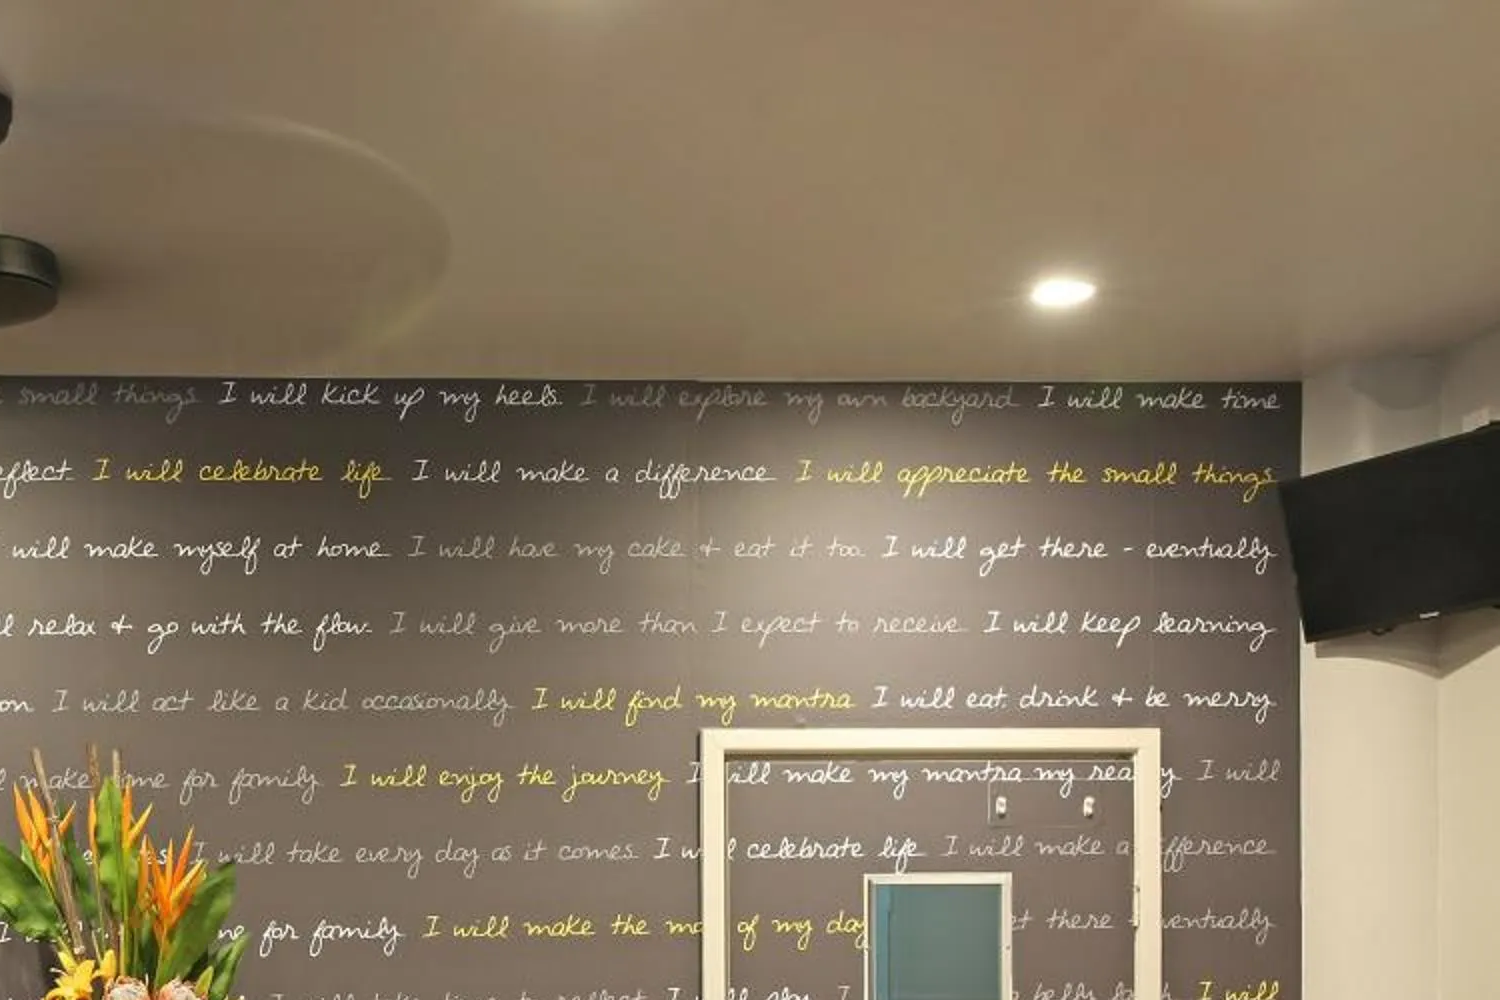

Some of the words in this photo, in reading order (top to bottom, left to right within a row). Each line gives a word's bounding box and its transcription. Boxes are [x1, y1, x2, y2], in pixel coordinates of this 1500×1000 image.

[392, 385, 426, 423] up
[1066, 385, 1124, 411] will
[1135, 386, 1207, 411] make
[1219, 387, 1282, 411] time
[197, 456, 326, 484] celebrate
[514, 457, 591, 485] make
[826, 459, 885, 485] will
[896, 459, 1033, 500] appreciate
[1099, 460, 1179, 486] small
[10, 534, 72, 561] will
[171, 534, 262, 577] myself
[271, 534, 305, 560] at
[626, 534, 687, 560] cake
[733, 534, 777, 560] eat
[978, 533, 1028, 579] get
[1037, 534, 1110, 560] there
[26, 611, 98, 638] relax
[146, 620, 181, 657] go
[190, 610, 248, 636] with
[258, 610, 305, 636] the
[487, 616, 543, 656] give
[636, 610, 699, 635] than
[710, 609, 728, 634] I
[740, 610, 823, 650] expect
[834, 609, 860, 633] to
[150, 687, 196, 714] act
[205, 687, 262, 714] like
[274, 695, 291, 713] a
[623, 683, 684, 729] find
[1017, 682, 1101, 710] drink
[1143, 684, 1172, 709] be
[178, 766, 220, 808] for
[437, 768, 506, 805] enjoy
[780, 759, 856, 786] make
[866, 766, 912, 802] my
[285, 839, 344, 866] take
[354, 845, 425, 881] every
[434, 837, 482, 881] day
[490, 843, 514, 863] as
[522, 838, 549, 862] it
[745, 834, 867, 861] celebrate
[258, 918, 302, 960] for
[520, 912, 598, 939] make
[608, 912, 652, 937] the
[735, 912, 761, 953] of
[1044, 907, 1115, 931] there
